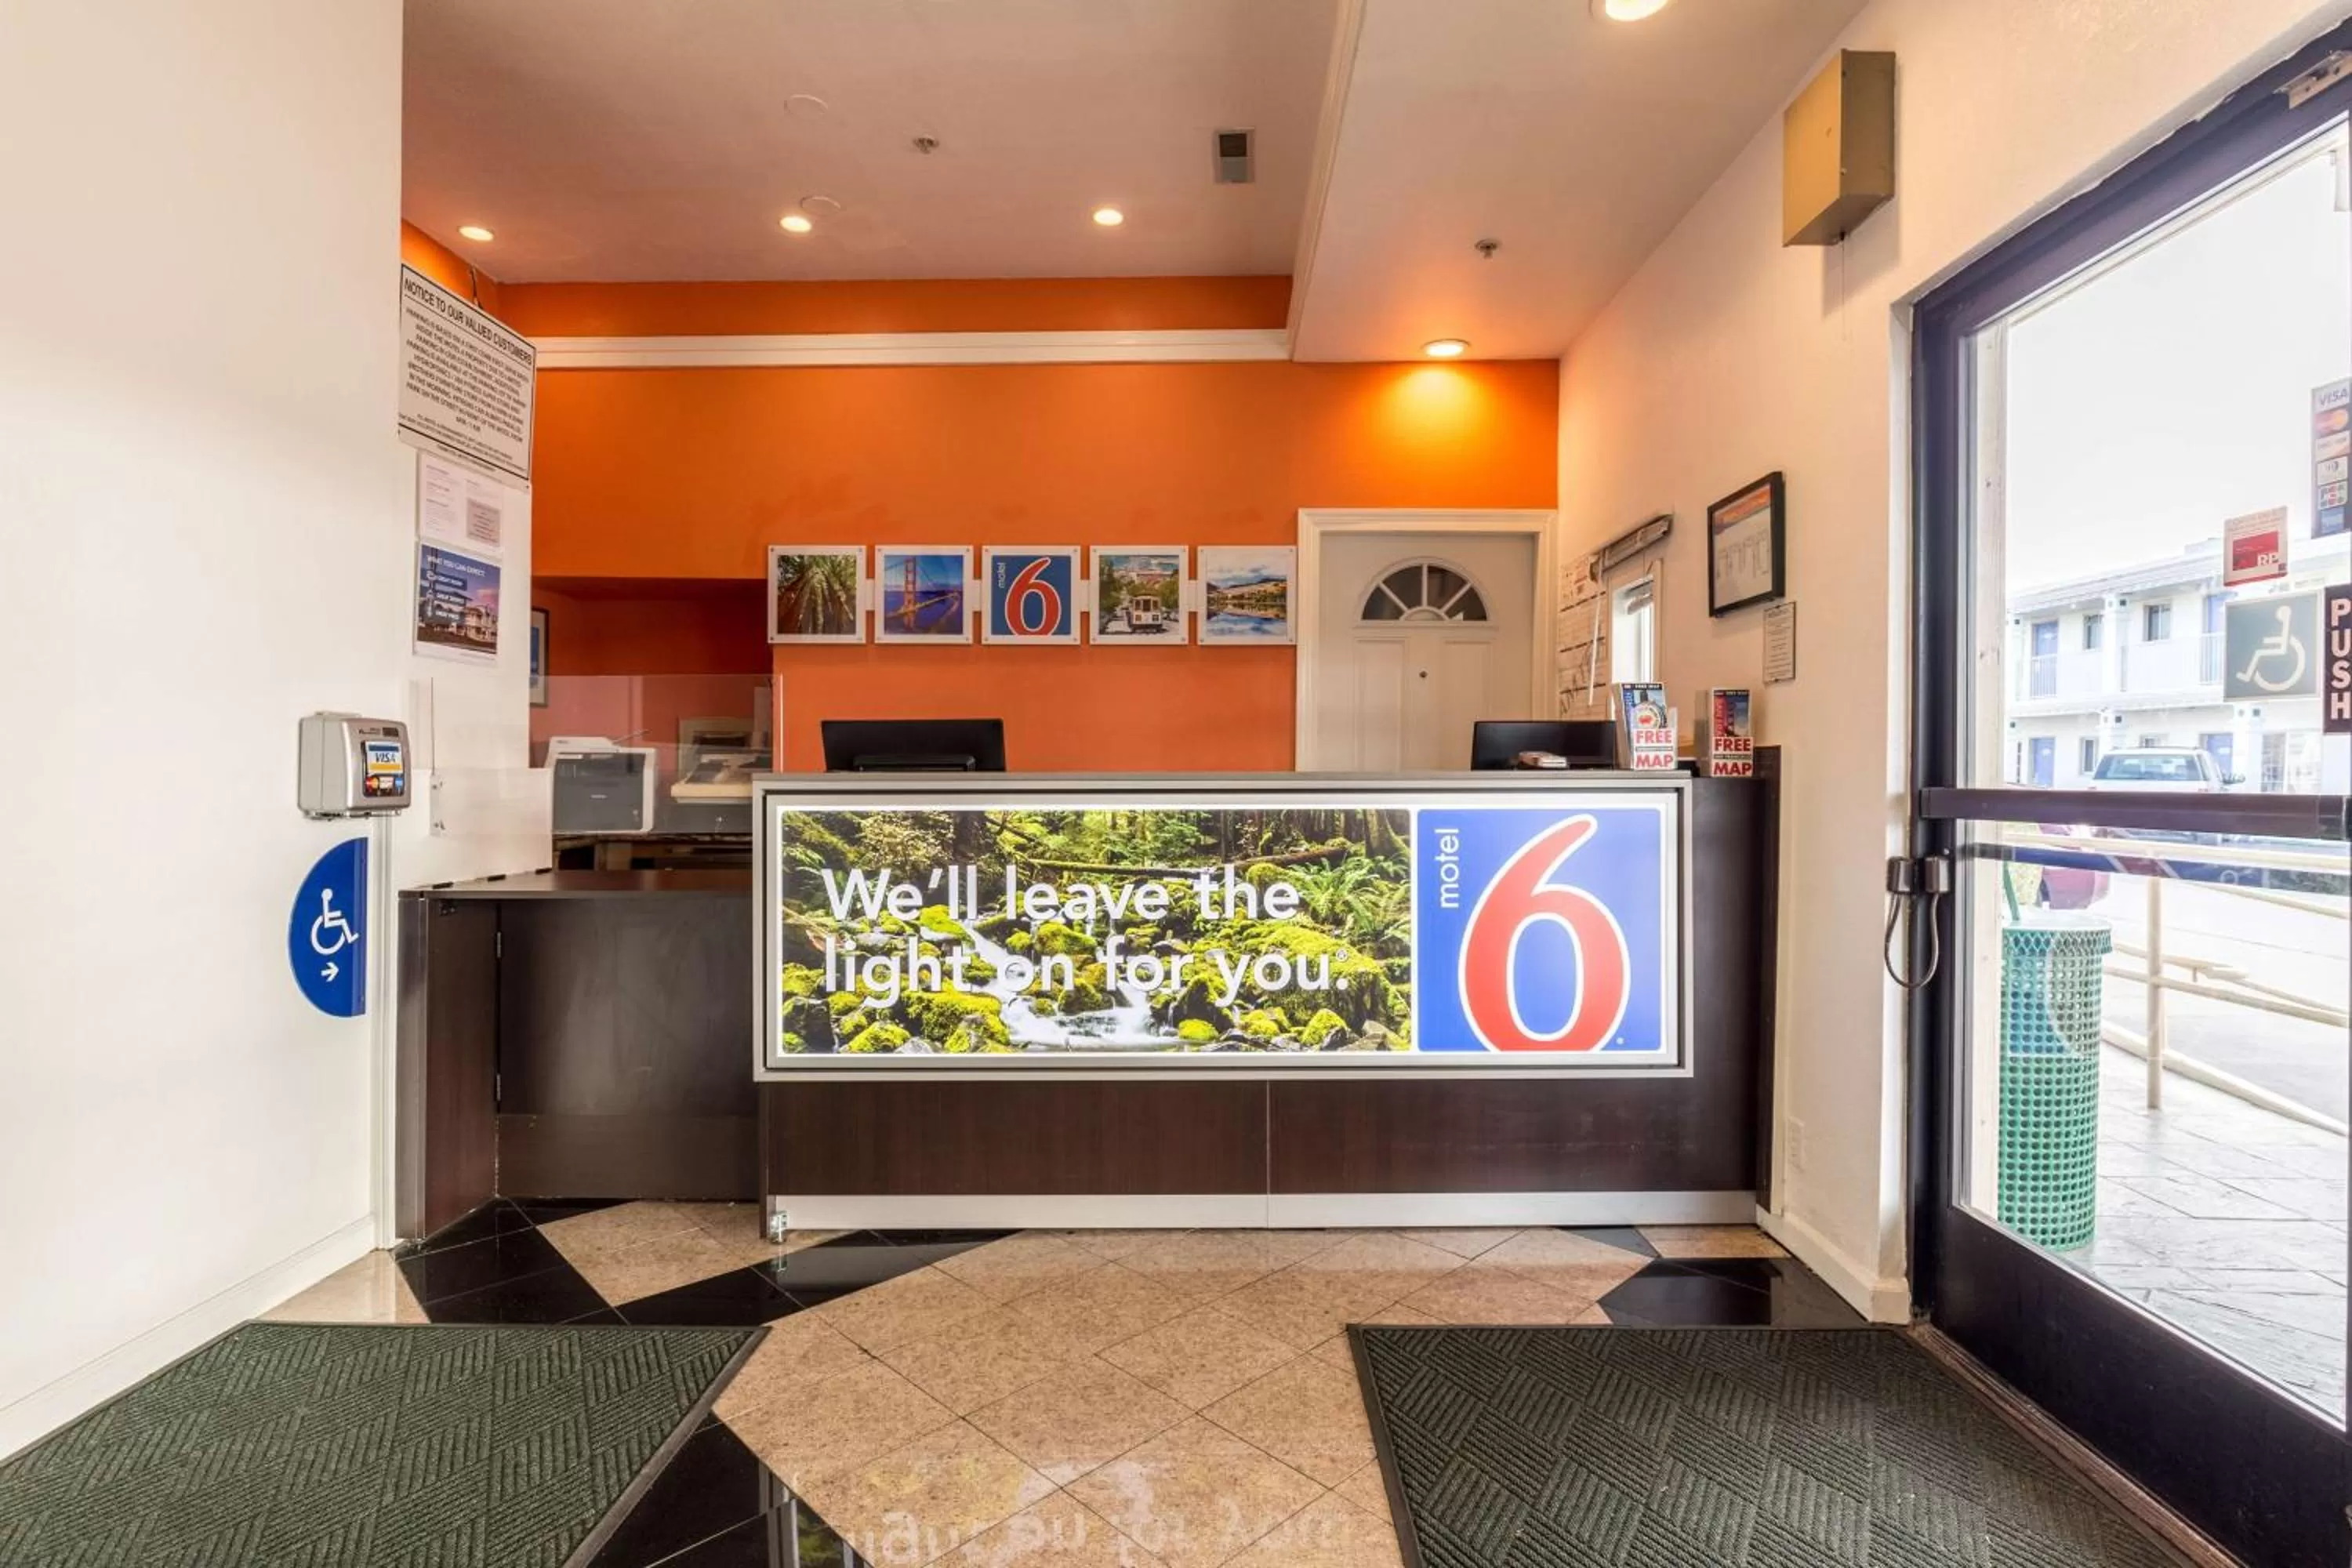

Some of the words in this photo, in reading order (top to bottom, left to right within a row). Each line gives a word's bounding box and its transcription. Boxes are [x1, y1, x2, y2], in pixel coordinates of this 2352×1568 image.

[405, 278, 435, 306] NOTICE
[435, 296, 446, 313] TO
[448, 304, 463, 323] OUR
[466, 316, 492, 341] VALUED
[494, 333, 532, 365] CUSTOMERS
[2318, 387, 2348, 406] VISA
[996, 562, 1007, 589] motel
[1004, 557, 1062, 636] 6
[2330, 598, 2351, 720] PUSH
[376, 753, 396, 763] VISA
[1635, 730, 1672, 744] FREE
[1715, 738, 1751, 752] FREE
[1635, 753, 1674, 768] MAP
[1714, 762, 1752, 775] MAP
[1434, 827, 1460, 909] motel
[822, 865, 978, 921] We'll
[1006, 864, 1169, 921] leave
[1193, 864, 1300, 920] the
[1457, 813, 1632, 1052] 6
[826, 935, 972, 1009] light
[996, 953, 1075, 993] on
[1097, 935, 1194, 992] for
